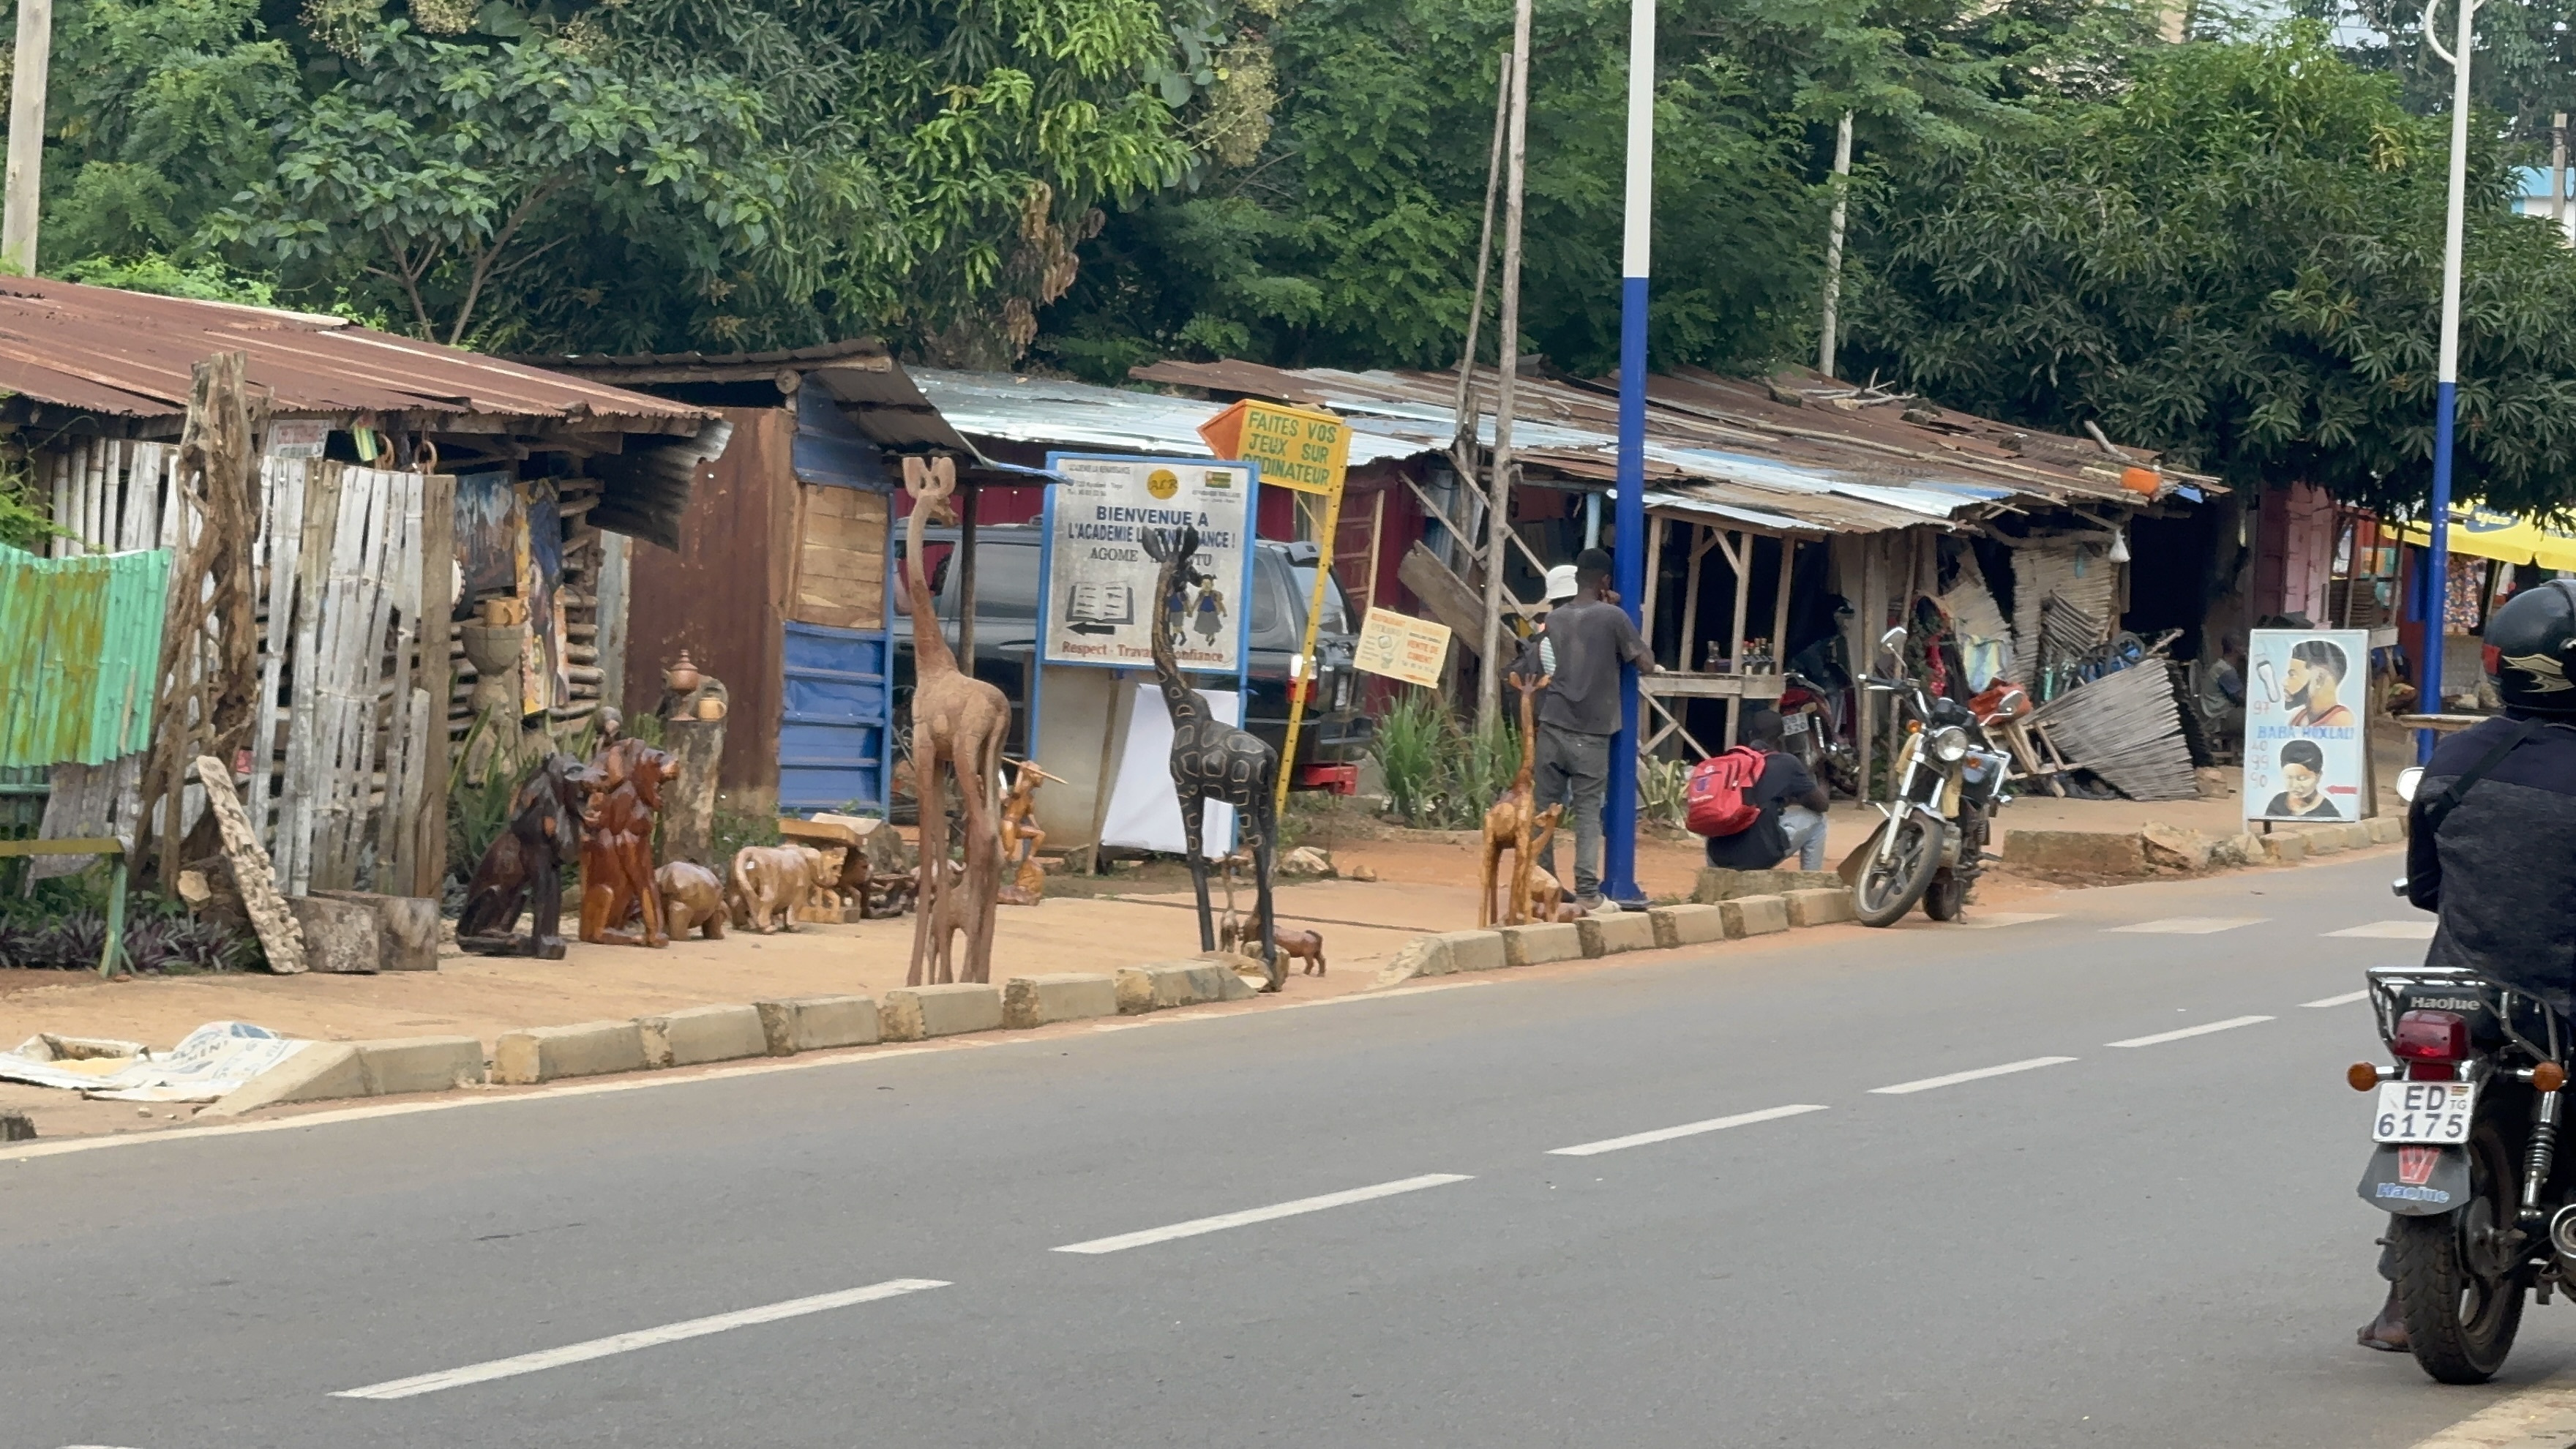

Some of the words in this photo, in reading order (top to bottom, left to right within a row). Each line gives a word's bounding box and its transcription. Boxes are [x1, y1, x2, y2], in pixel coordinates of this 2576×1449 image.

[1248, 411, 1300, 437] FAITES
[1308, 422, 1337, 443] VOS
[1248, 433, 1288, 456] JEUX
[1300, 443, 1329, 464] SUR
[1097, 506, 1192, 525] BIENVENUE
[1198, 512, 1209, 527] A
[1068, 523, 1132, 542] L'ACADEMIE
[1090, 547, 1138, 563] AGOME
[1062, 641, 1107, 657] Respect
[1175, 648, 1224, 662] onfiance
[2257, 726, 2295, 738] BABA
[2404, 1085, 2446, 1111] ED
[2450, 1099, 2467, 1110] TG
[2378, 1112, 2463, 1139] 6175
